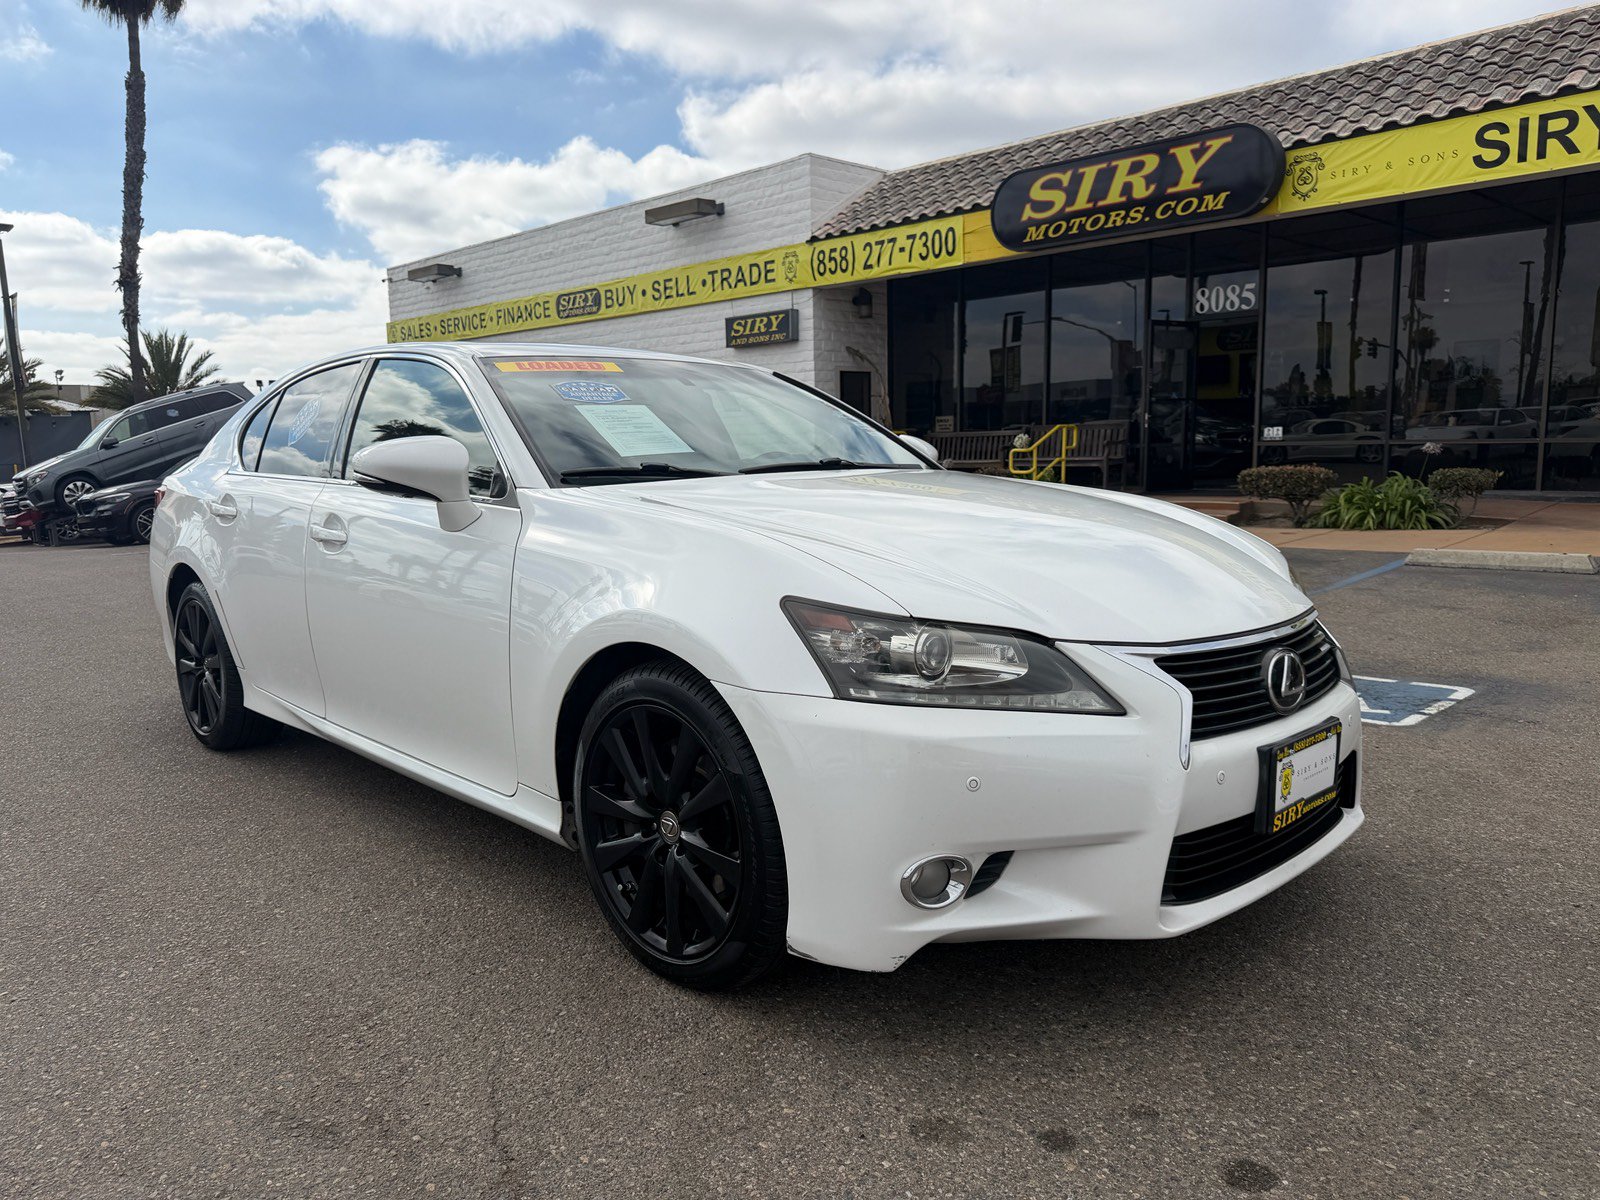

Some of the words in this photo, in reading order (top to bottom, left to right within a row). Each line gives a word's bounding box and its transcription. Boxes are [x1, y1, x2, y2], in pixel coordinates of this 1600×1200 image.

[1020, 134, 1234, 224] SIRY
[1330, 164, 1372, 180] SIRY
[1385, 161, 1393, 170] &
[1408, 149, 1459, 166] SONS
[1022, 191, 1231, 243] MOTORS.COM
[810, 240, 856, 281] (858)
[862, 226, 956, 271] 277-7300
[559, 290, 598, 311] SIRY
[604, 284, 637, 309] BUY
[652, 275, 697, 301] SELL
[707, 260, 776, 292] TRADE
[1195, 282, 1256, 314] 8085
[400, 322, 432, 341] SALES
[440, 312, 487, 335] SERVICE
[495, 300, 551, 326] FINANCE
[730, 313, 786, 337] SIRY
[730, 337, 747, 346] AND
[748, 335, 769, 344] SONS
[770, 332, 786, 341] INC
[515, 361, 606, 371] LOADED
